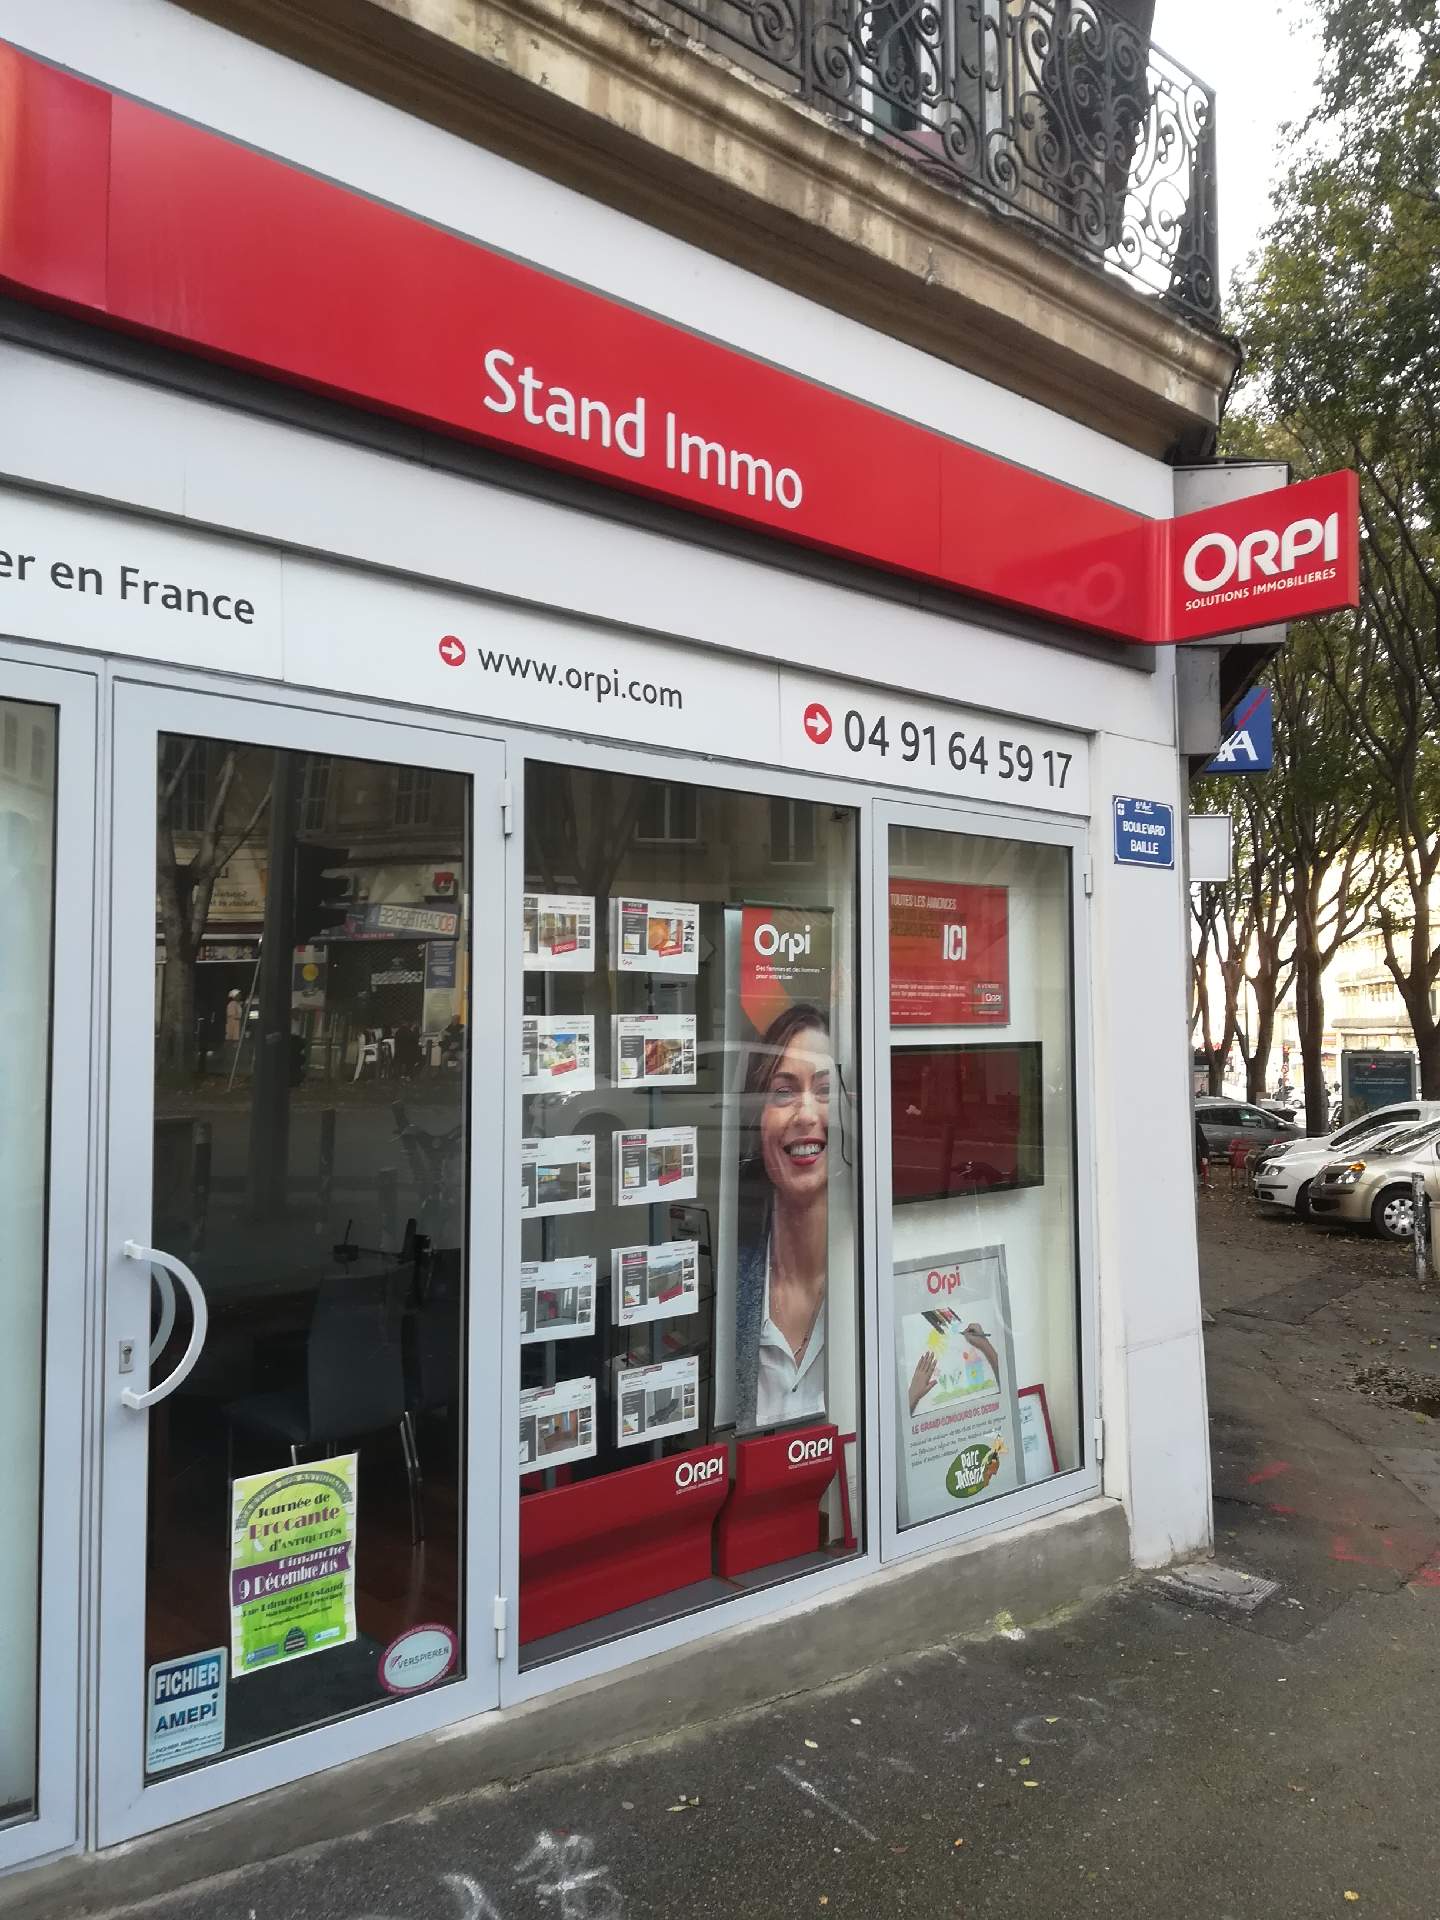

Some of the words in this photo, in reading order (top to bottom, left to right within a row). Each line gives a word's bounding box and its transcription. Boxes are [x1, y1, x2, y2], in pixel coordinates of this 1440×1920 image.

[483, 348, 646, 459] Stand
[666, 411, 803, 509] Immo
[1183, 511, 1339, 593] ORPI
[50, 561, 103, 596] en
[120, 565, 255, 625] France
[1185, 587, 1250, 612] SOLUTIONS
[1253, 567, 1337, 596] IMMOBILIERES
[477, 648, 683, 709] www.orpi.com
[844, 709, 890, 757] 04
[900, 721, 936, 766] 91
[948, 731, 989, 775] 64
[998, 740, 1033, 782] 59
[1041, 750, 1073, 789] 17
[1122, 820, 1166, 837] BOULEVARD
[1130, 839, 1159, 855] BAILLE
[914, 895, 926, 908] LES
[753, 923, 811, 962] Orpi
[943, 924, 967, 961] ICI
[926, 1265, 961, 1295] Orpi
[788, 1437, 833, 1463] ORPI
[675, 1456, 723, 1488] ORPI
[313, 1493, 330, 1505] de
[238, 1578, 250, 1600] 9
[254, 1563, 318, 1595] Décembre
[398, 1646, 450, 1669] VERSPIEREN
[155, 1662, 219, 1700] FICHIER
